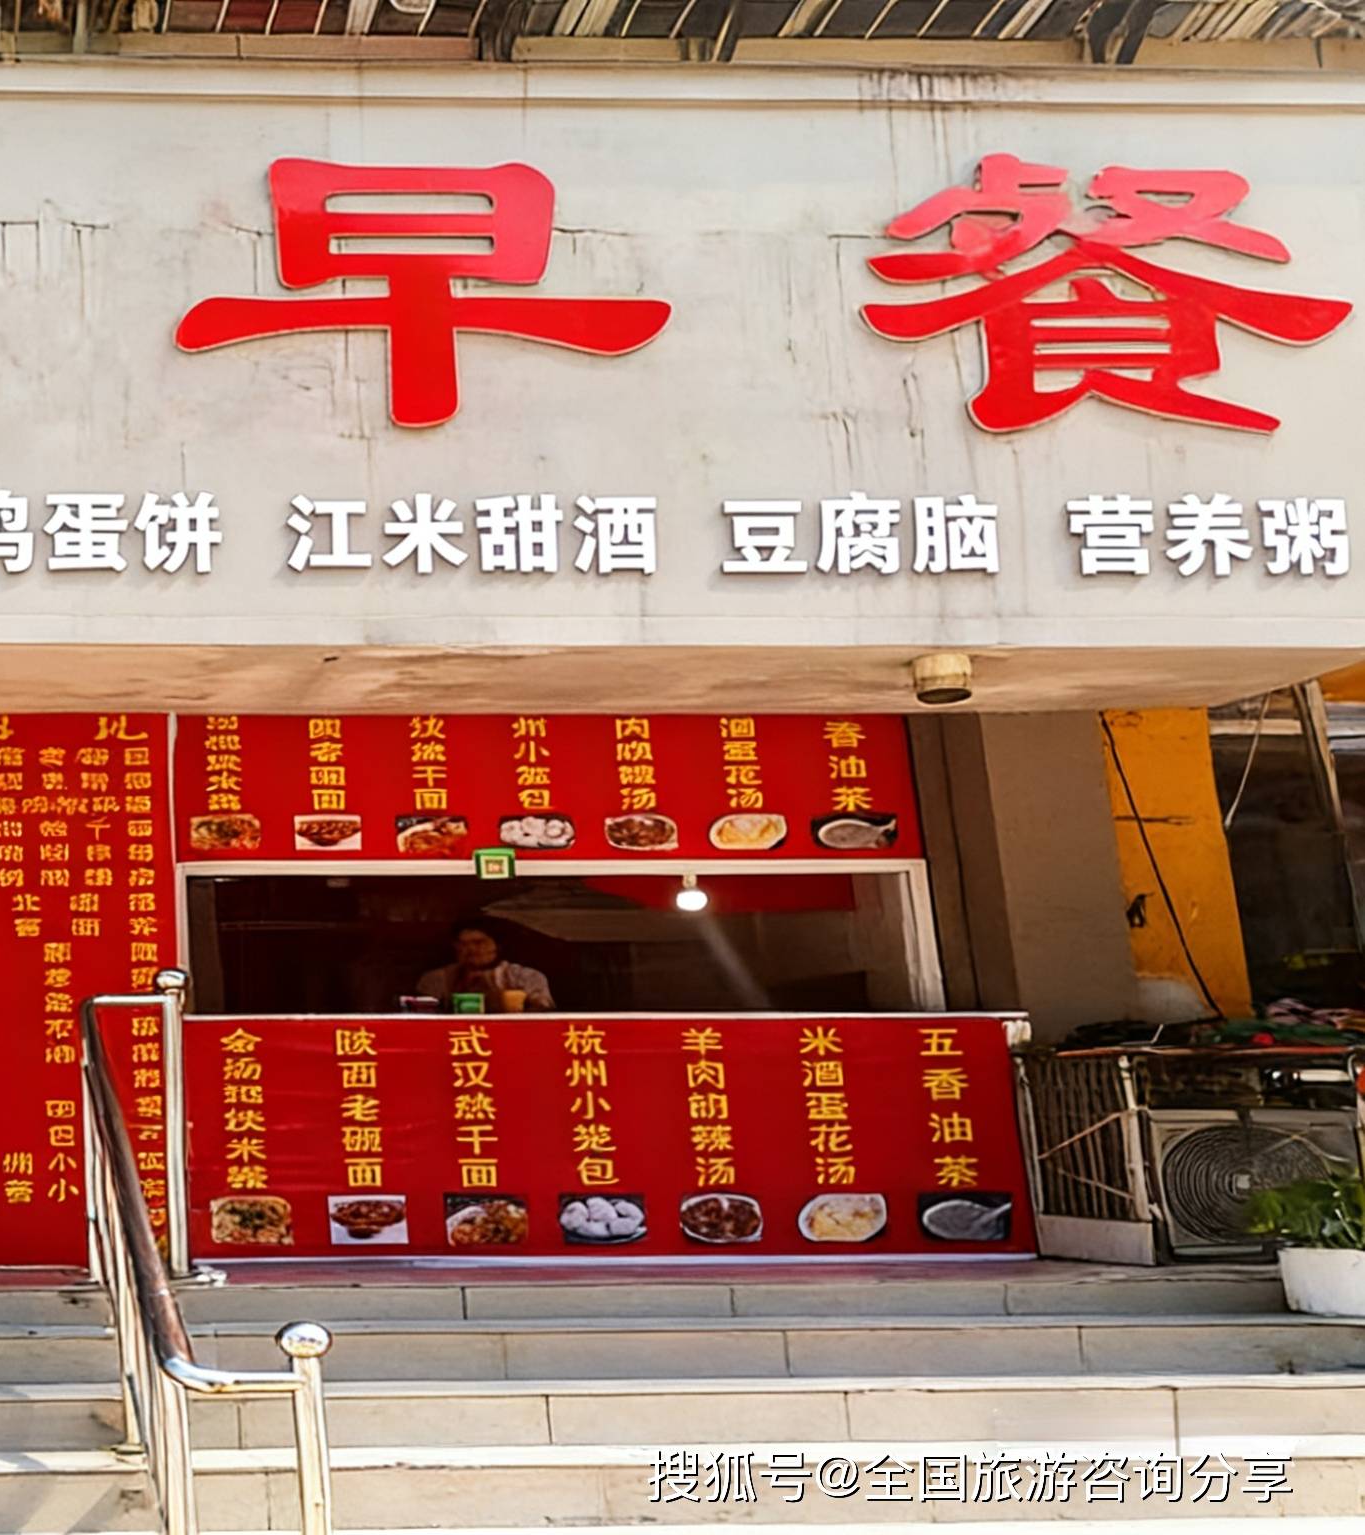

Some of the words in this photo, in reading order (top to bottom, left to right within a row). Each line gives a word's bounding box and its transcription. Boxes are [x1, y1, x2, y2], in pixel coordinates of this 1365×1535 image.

[287, 494, 658, 576] 江米甜酒
[723, 492, 1000, 576] 豆腐脑
[1066, 494, 1350, 578] 营养粥
[918, 1027, 979, 1188] 五香油茶
